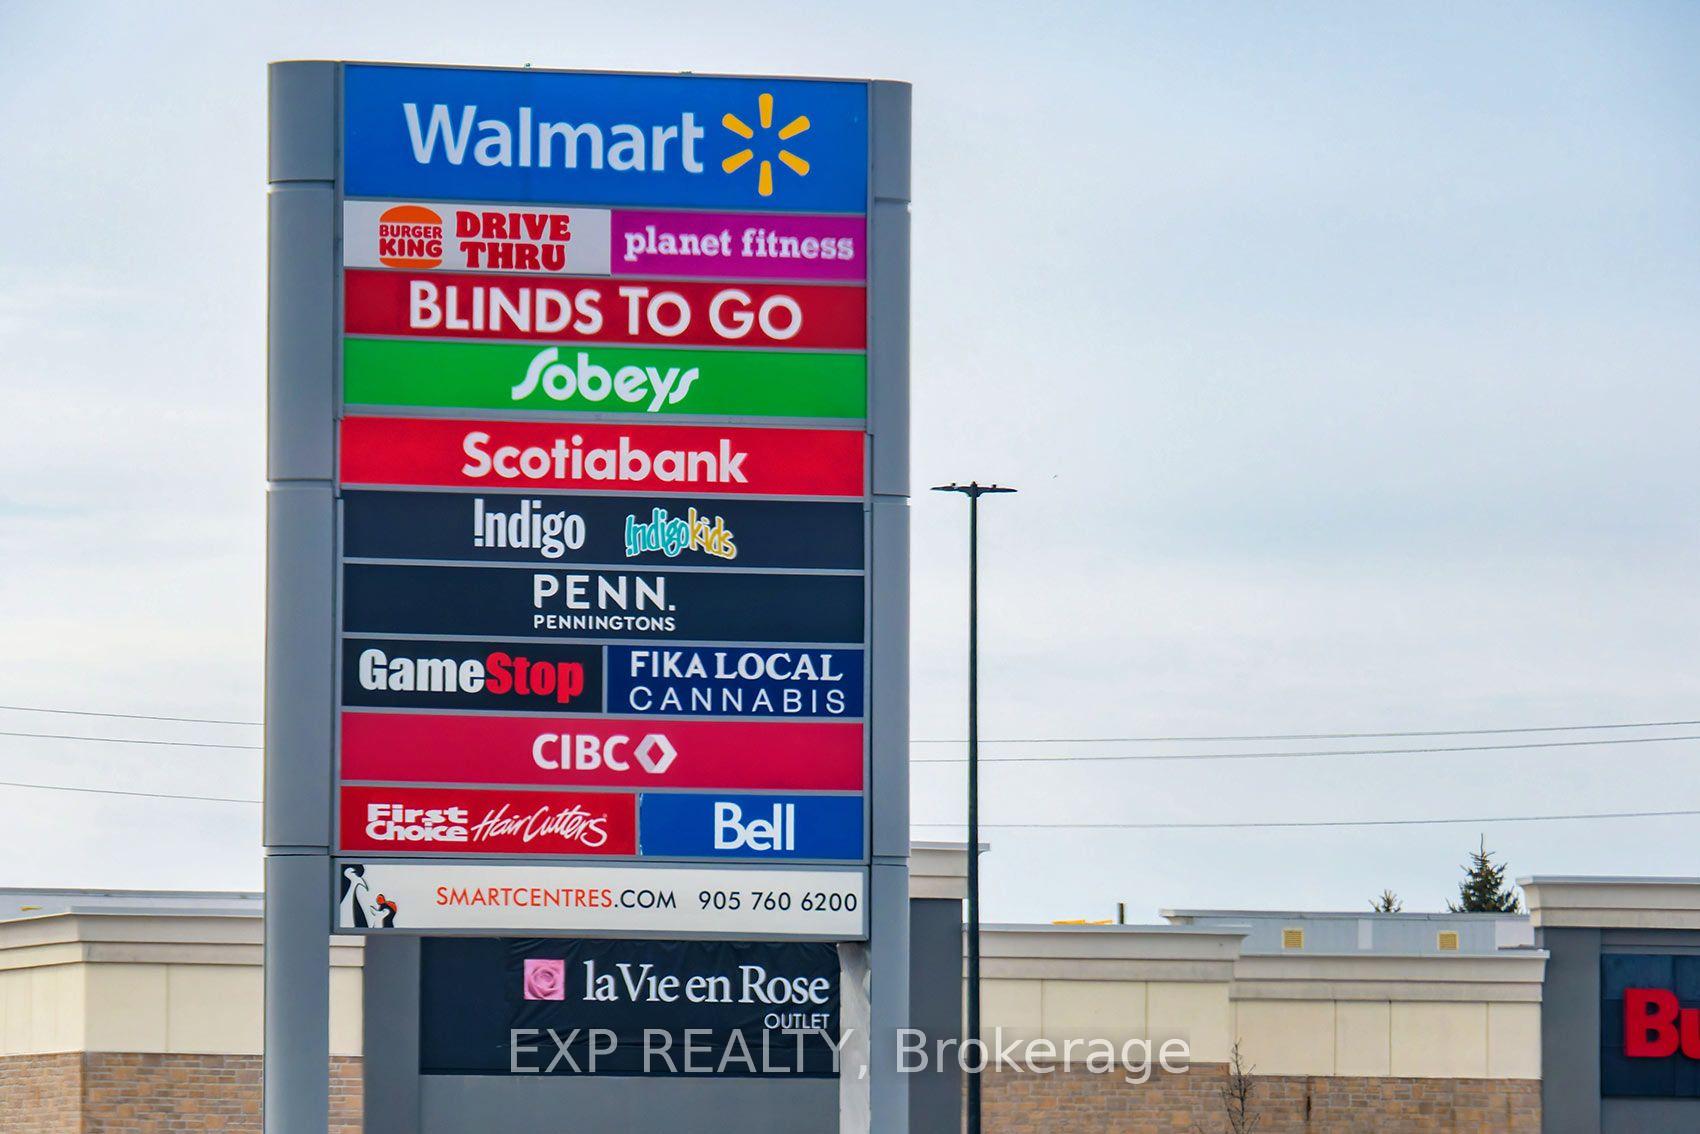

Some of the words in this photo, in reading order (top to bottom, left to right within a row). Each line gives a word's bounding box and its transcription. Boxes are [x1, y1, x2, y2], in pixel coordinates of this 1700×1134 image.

[403, 102, 705, 174] Walmart
[379, 223, 443, 240] BURGER
[456, 211, 571, 241] DRIVE
[379, 238, 443, 259] KING
[460, 241, 566, 271] THRU
[624, 225, 733, 262] planet
[740, 229, 855, 260] fitness
[409, 280, 603, 333] BLINDS
[618, 286, 692, 337] TO
[708, 289, 803, 340] GO
[511, 347, 699, 412] Sobeys
[461, 432, 748, 483] Scotiabank
[533, 574, 676, 611] PENN.
[533, 614, 676, 632] PENNINGTONS
[358, 648, 584, 704] GameStop
[631, 651, 708, 679] FIKA
[713, 652, 843, 682] LOCAL
[629, 686, 845, 714] CANNABIS
[532, 733, 630, 771] CIBC
[367, 803, 469, 823] First
[713, 802, 795, 852] Bell
[365, 820, 469, 842] Choice
[436, 886, 677, 910] SMARTCENTRES.COM
[699, 890, 741, 911] 905
[751, 891, 792, 912] 760
[801, 891, 858, 913] 6200
[685, 975, 733, 1003] en
[738, 965, 831, 1005] Rose
[764, 1013, 831, 1029] OUTLET
